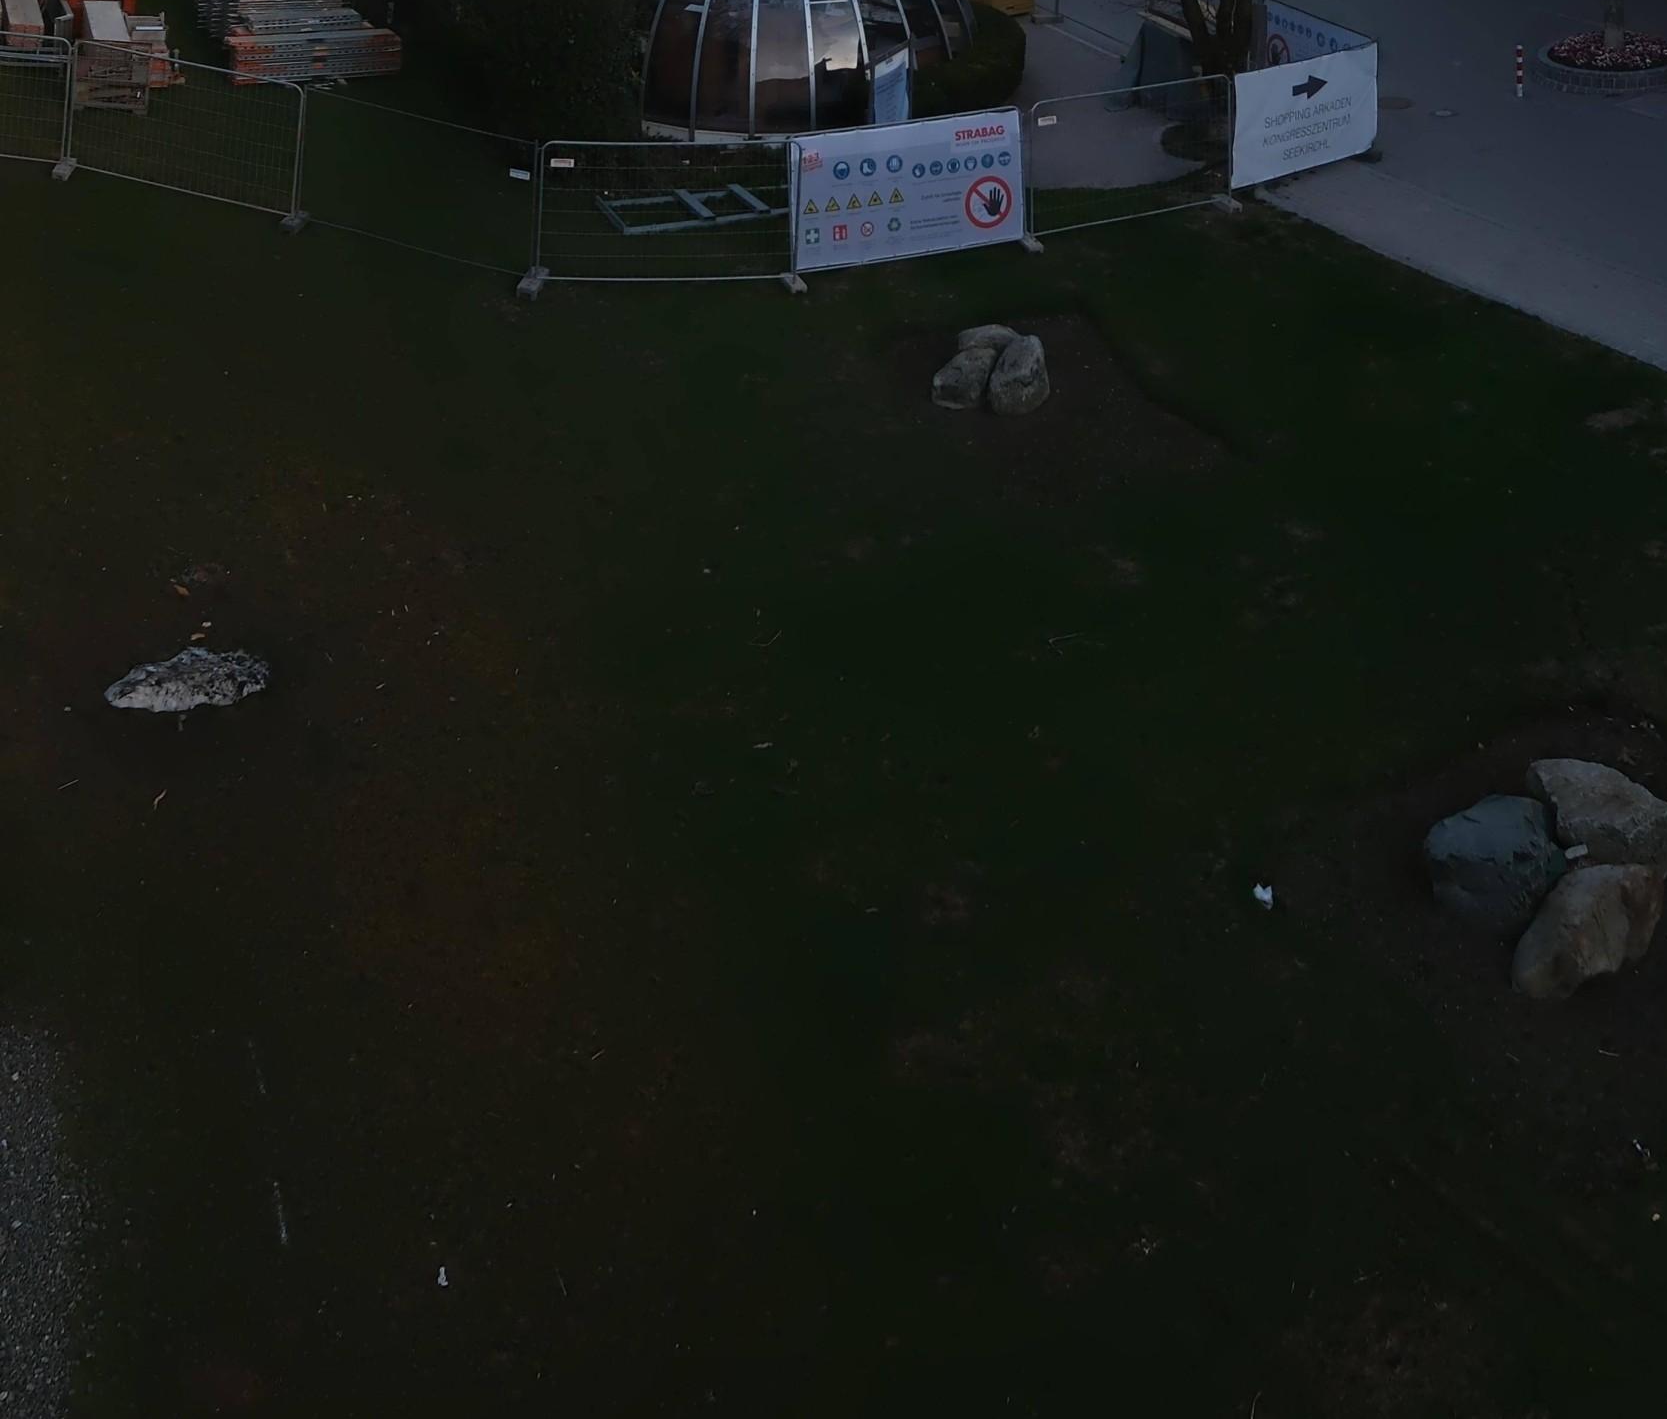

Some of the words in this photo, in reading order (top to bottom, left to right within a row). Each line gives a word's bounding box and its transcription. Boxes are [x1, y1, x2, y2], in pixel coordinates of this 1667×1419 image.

[1264, 107, 1311, 129] SHOPPING
[1312, 97, 1351, 118] ARKADEN
[955, 125, 1005, 141] STRABAG
[1262, 114, 1351, 148] KONGRESSZENTRUM
[1282, 138, 1331, 161] SEEKIRCHL
